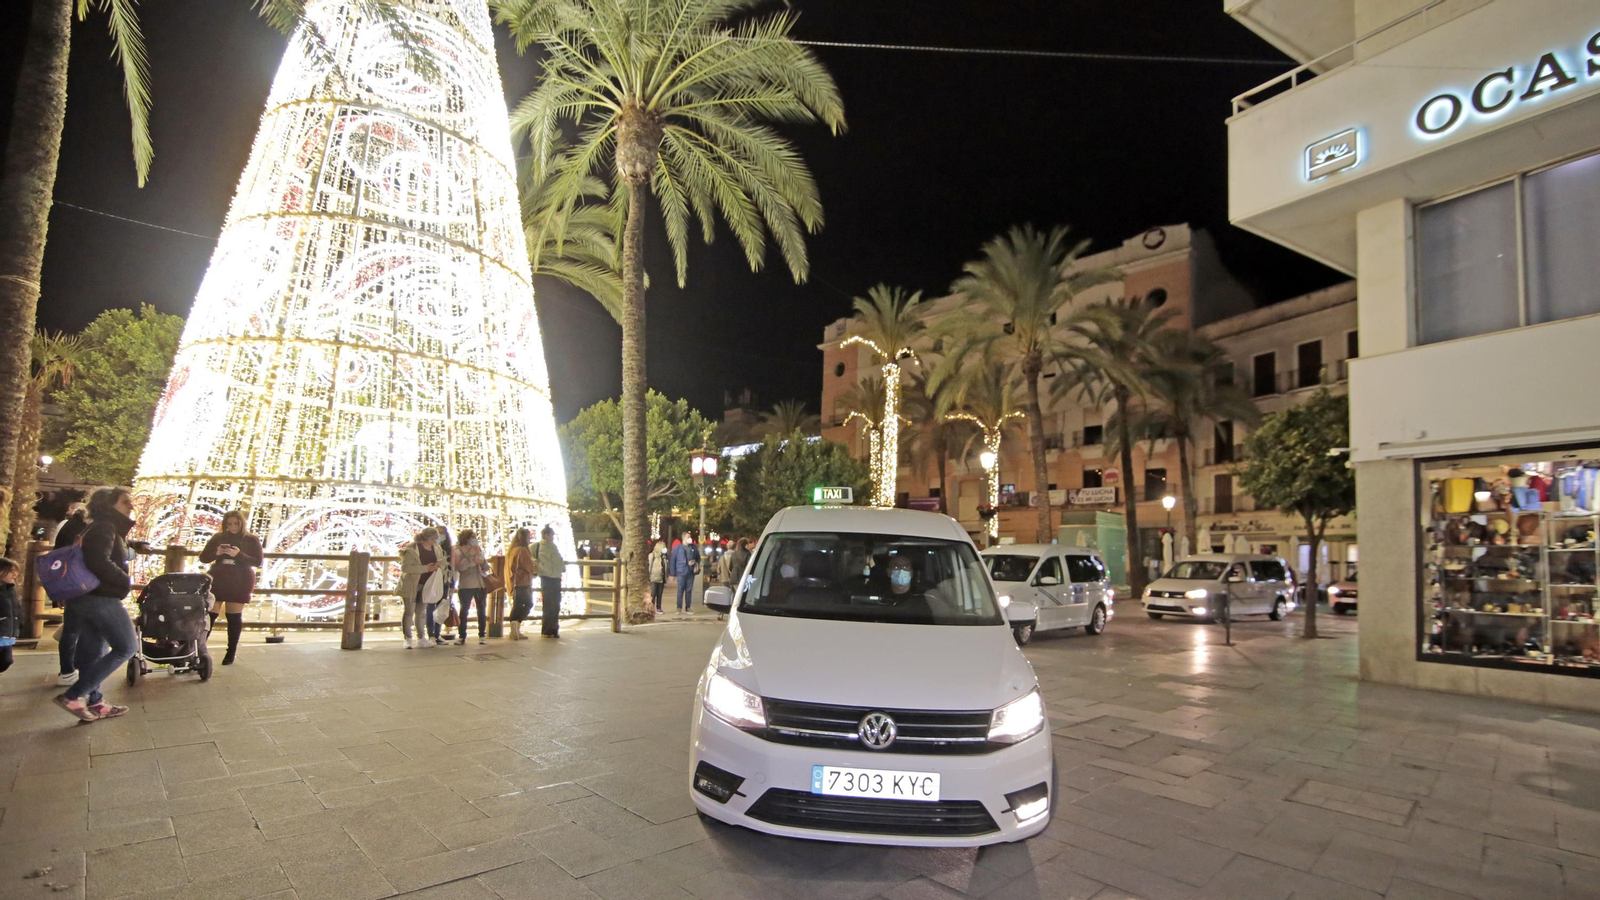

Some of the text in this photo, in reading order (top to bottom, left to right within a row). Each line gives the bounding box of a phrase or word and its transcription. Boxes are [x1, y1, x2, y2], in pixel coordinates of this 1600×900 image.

[823, 488, 842, 499] TAXI
[828, 770, 934, 797] 7303 KYC
